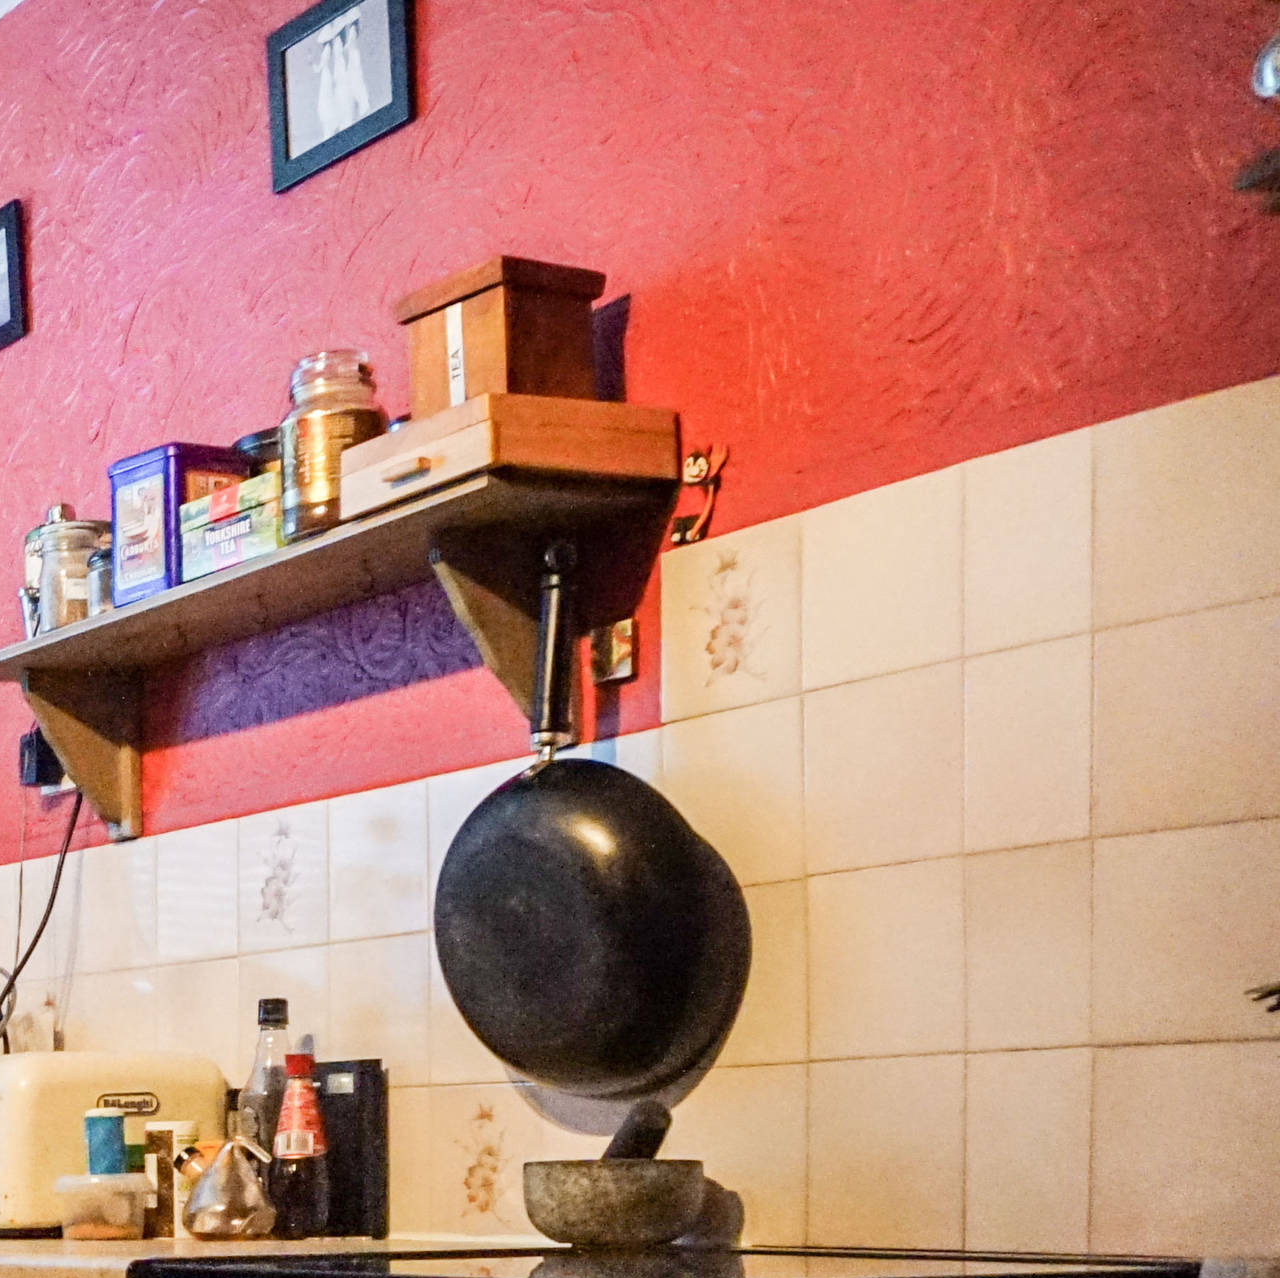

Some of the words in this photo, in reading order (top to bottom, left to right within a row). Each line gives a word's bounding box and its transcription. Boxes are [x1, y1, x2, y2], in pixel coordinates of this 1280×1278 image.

[450, 348, 462, 380] TEA
[204, 518, 252, 547] YORKSHIRE
[220, 538, 237, 556] TEA
